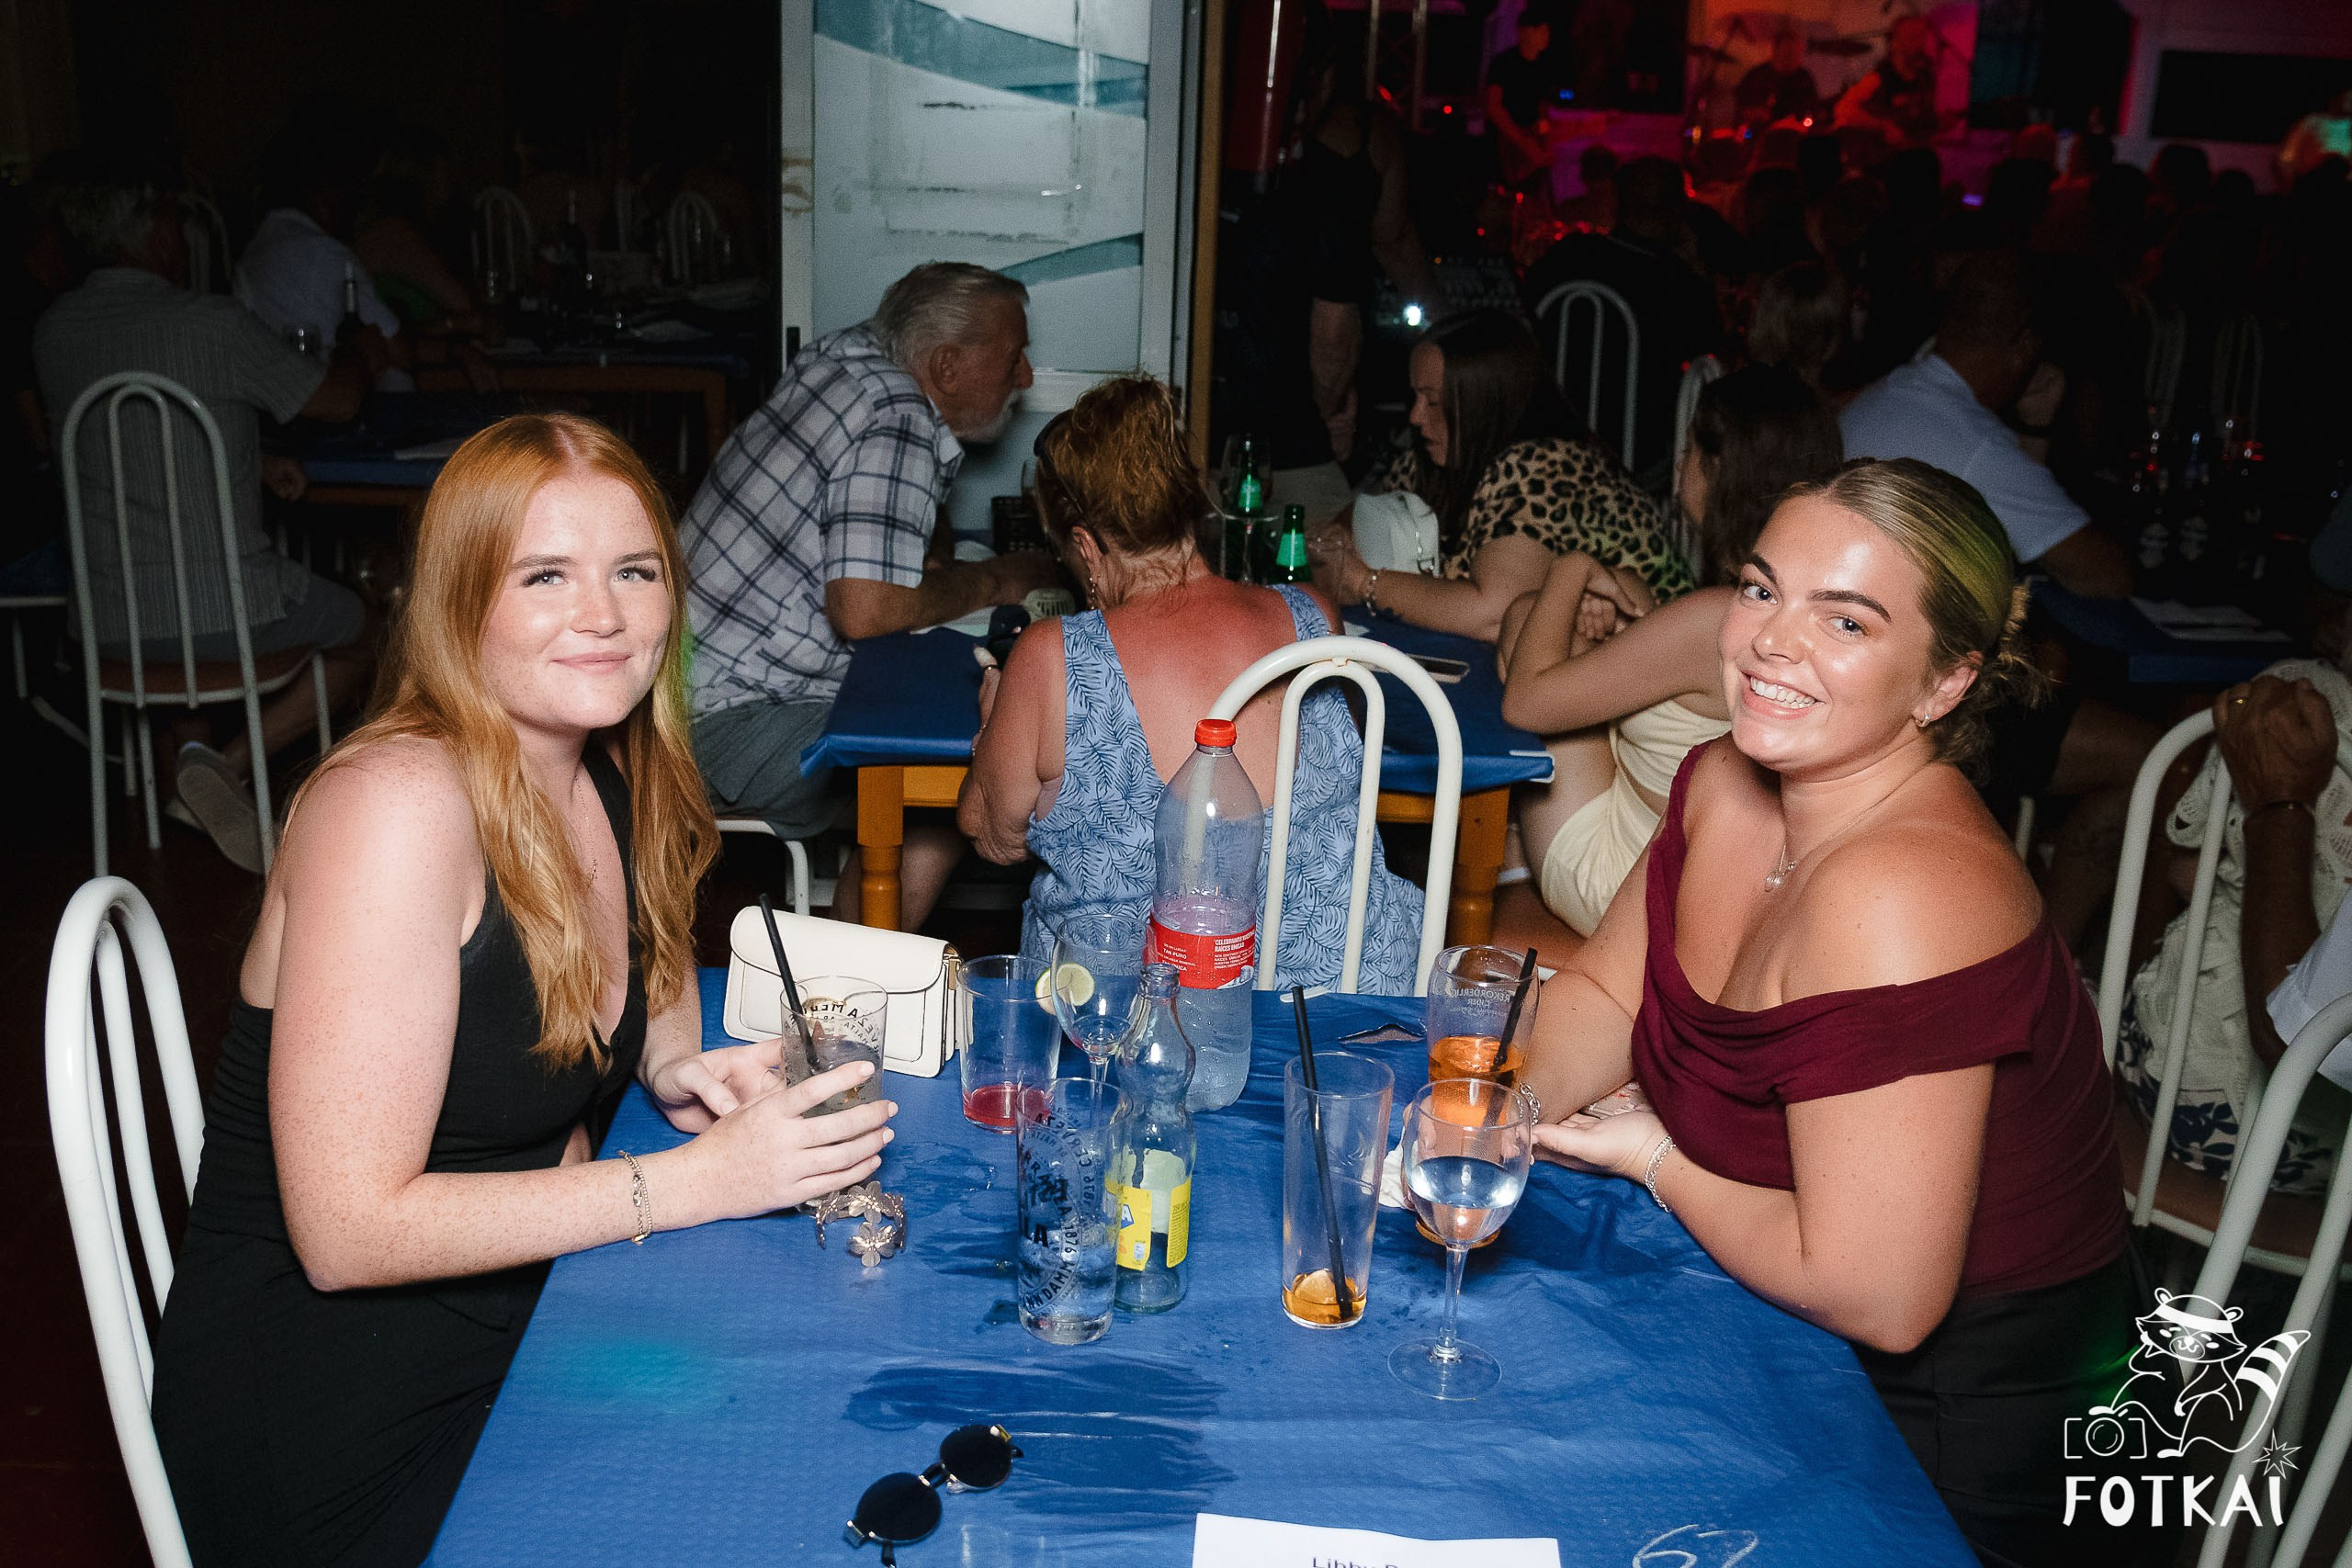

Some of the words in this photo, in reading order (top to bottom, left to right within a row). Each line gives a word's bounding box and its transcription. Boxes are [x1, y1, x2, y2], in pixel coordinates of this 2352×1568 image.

[1064, 1224, 1079, 1253] 1876
[1042, 1260, 1076, 1301] DAMM
[1313, 1557, 1376, 1568] Libb
